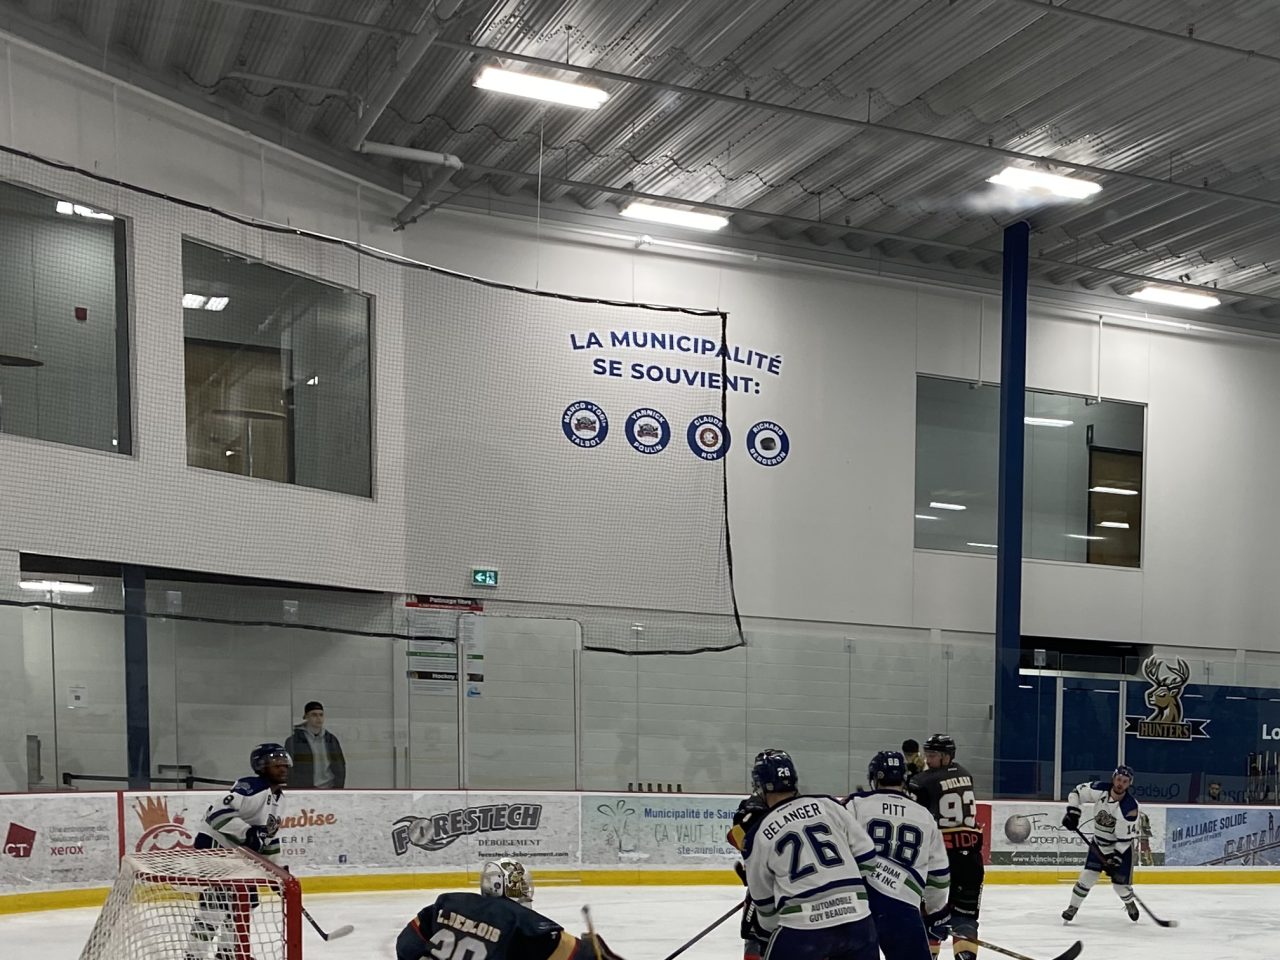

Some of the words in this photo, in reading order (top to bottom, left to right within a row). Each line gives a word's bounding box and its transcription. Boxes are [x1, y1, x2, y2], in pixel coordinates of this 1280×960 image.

[570, 332, 603, 350] LA
[610, 331, 782, 375] MUNICIPALITÉ
[593, 358, 622, 377] SE
[631, 363, 760, 394] SOUVIENT:
[563, 402, 586, 423] MARCO
[631, 409, 665, 423] YANNICK
[694, 416, 723, 428] CLAUDE
[752, 422, 783, 436] RICHARD
[571, 435, 600, 447] TALBOT
[633, 441, 663, 453] POULIN
[749, 447, 786, 465] BERGERON
[1140, 722, 1190, 738] HUNTERS
[777, 767, 790, 777] 26
[644, 808, 700, 820] Municipalité
[703, 809, 715, 819] de
[882, 803, 906, 816] PITT
[939, 790, 976, 828] 93
[763, 803, 822, 840] BELANGER
[1172, 828, 1184, 842] UN
[1185, 821, 1218, 838] ALLIAGE
[1220, 812, 1248, 830] SOLIDE
[676, 823, 704, 843] VAUT
[50, 846, 84, 856] xerox
[775, 821, 845, 883] 26
[876, 862, 901, 880] U-DIAM
[881, 875, 897, 890] INC.
[811, 896, 852, 912] AUTOMOBILE
[809, 913, 825, 923] GUY
[825, 906, 858, 919] BEAUDOIN
